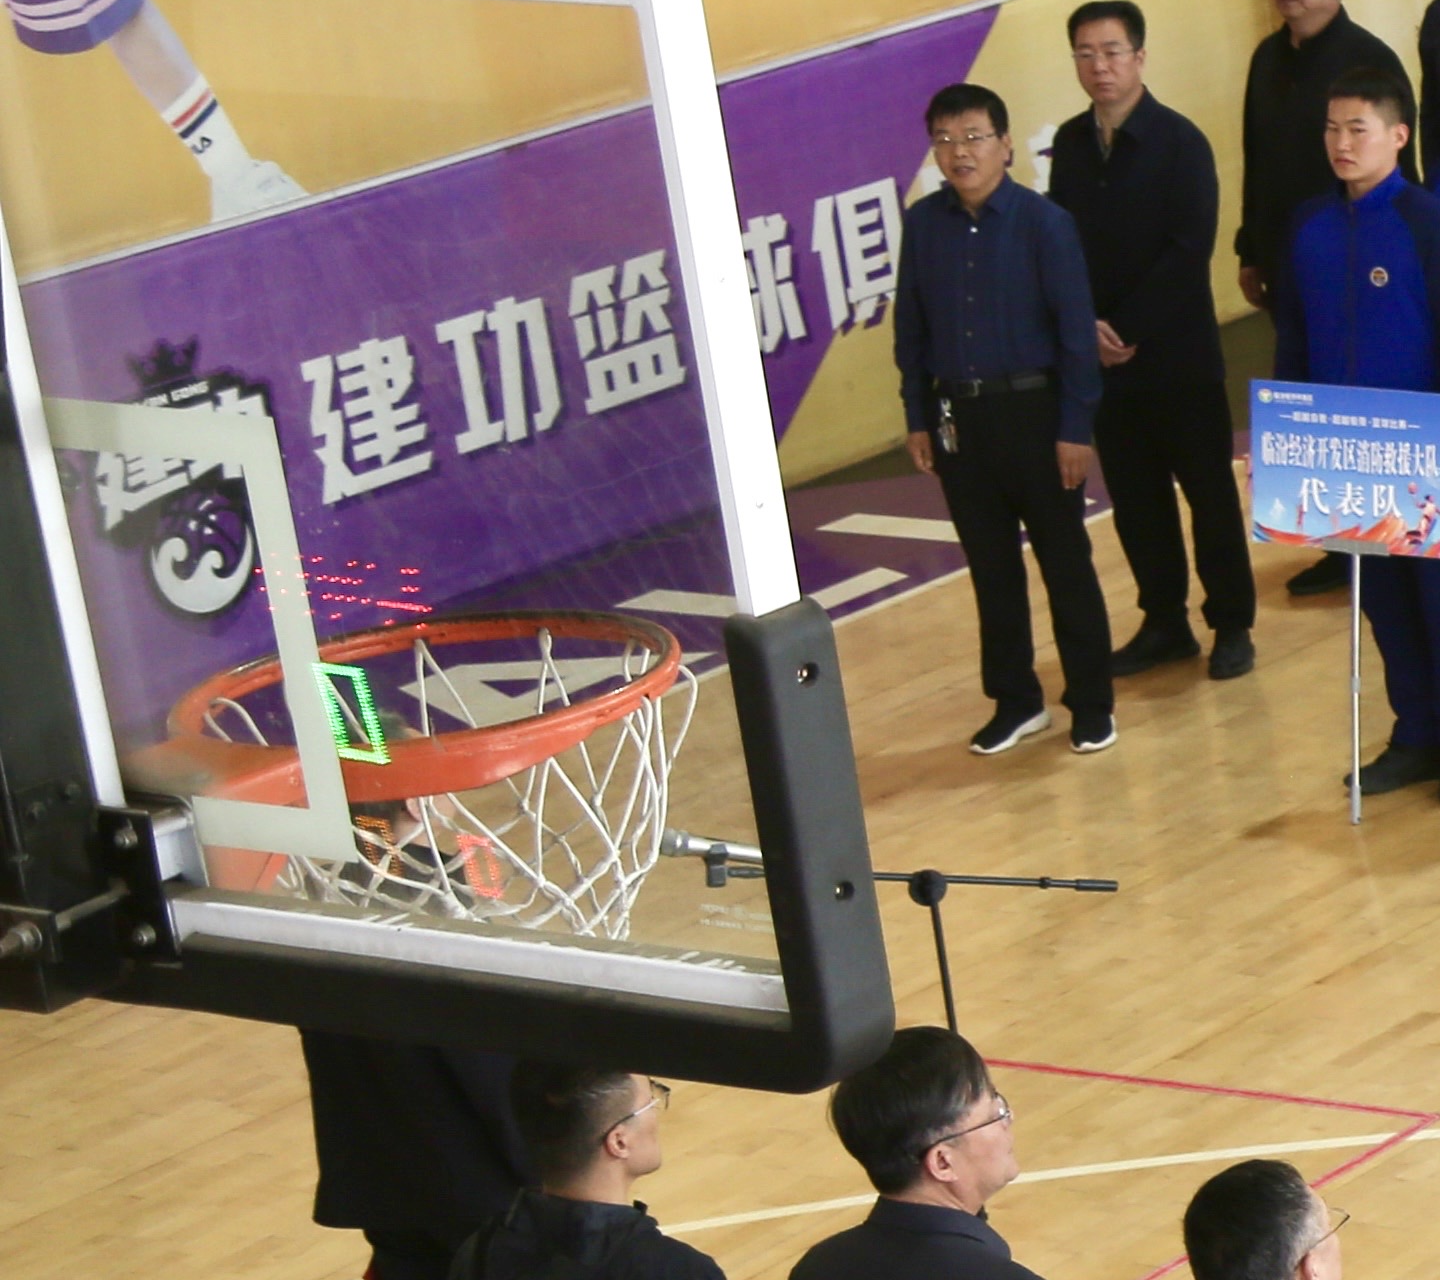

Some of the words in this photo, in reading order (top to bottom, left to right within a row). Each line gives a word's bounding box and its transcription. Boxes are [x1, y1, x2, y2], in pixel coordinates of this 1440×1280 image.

[1261, 431, 1440, 478] 临汾经济开发区消防救援大队
[1299, 477, 1403, 519] 代表队
